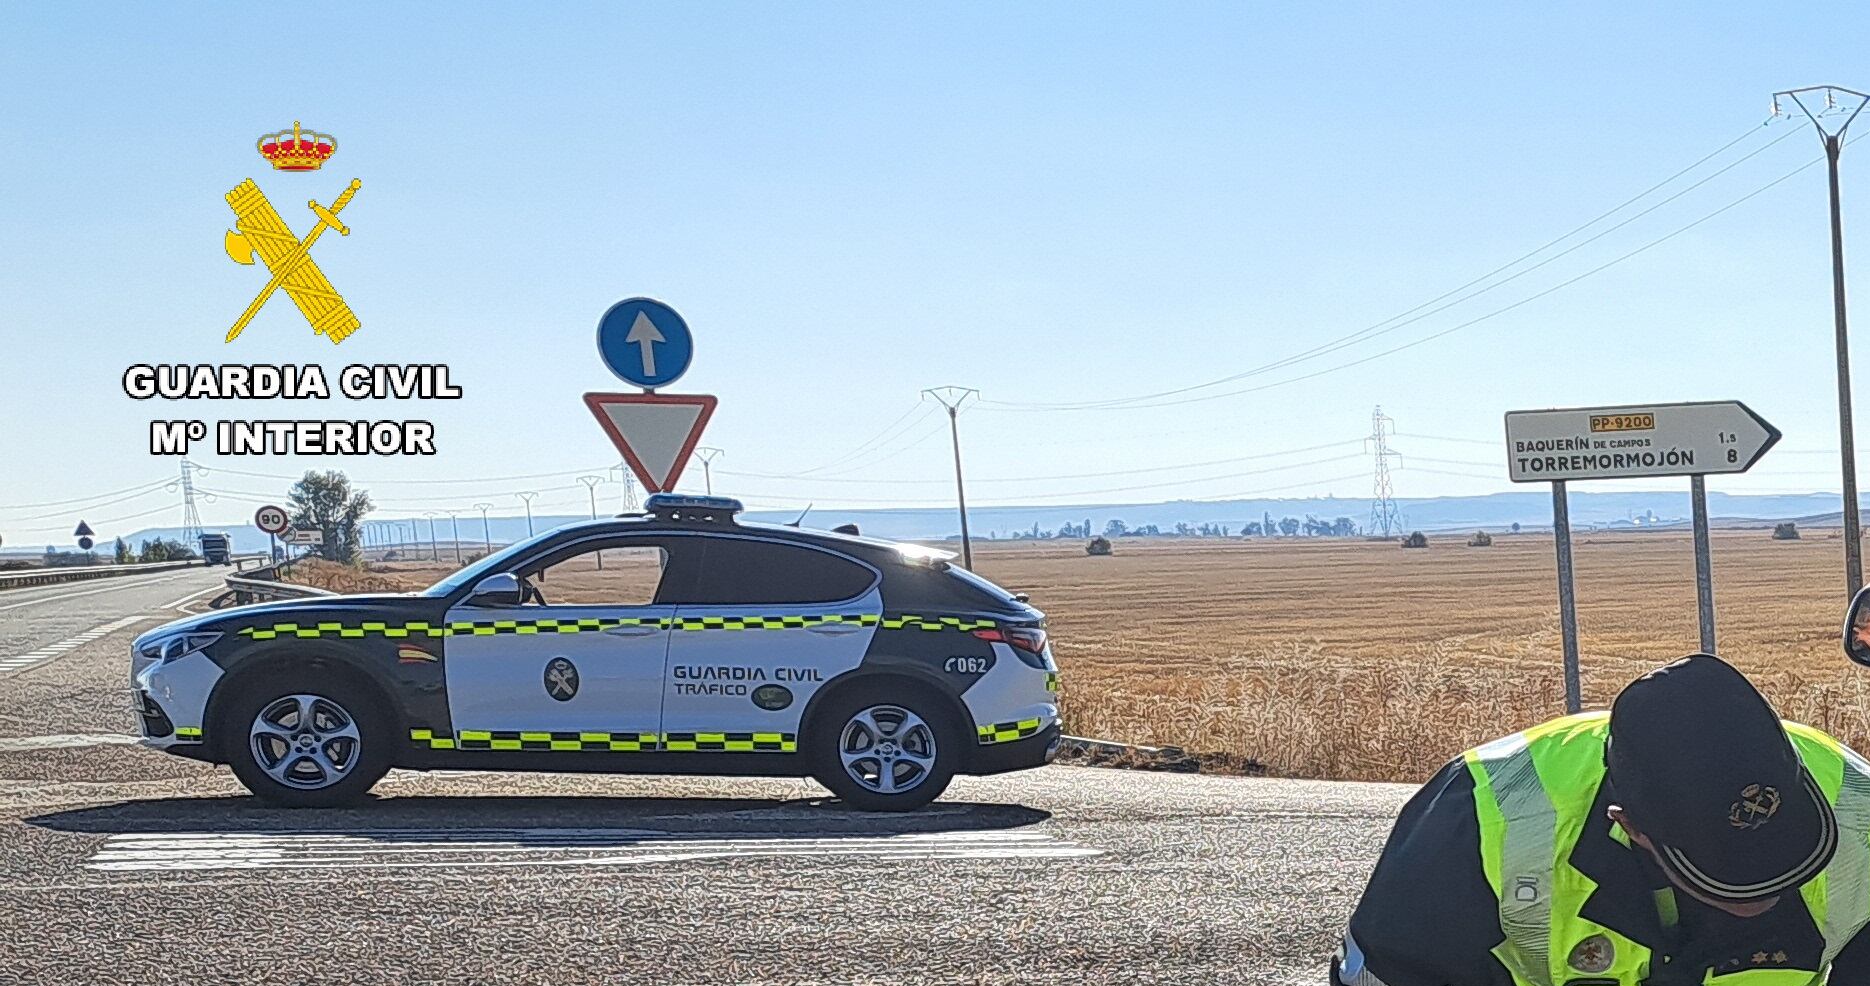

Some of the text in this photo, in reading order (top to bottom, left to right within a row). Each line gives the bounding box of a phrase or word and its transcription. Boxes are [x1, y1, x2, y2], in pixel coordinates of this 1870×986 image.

[1516, 436, 1589, 452] BAQUERÍN
[1593, 440, 1607, 449] DE
[1609, 439, 1651, 449] CAMPOS
[1518, 447, 1737, 472] TORREMORMOJÓN 8
[957, 657, 987, 673] 062
[674, 666, 823, 681] GUARDIA CIVIL
[674, 682, 747, 696] TRÁFICO
